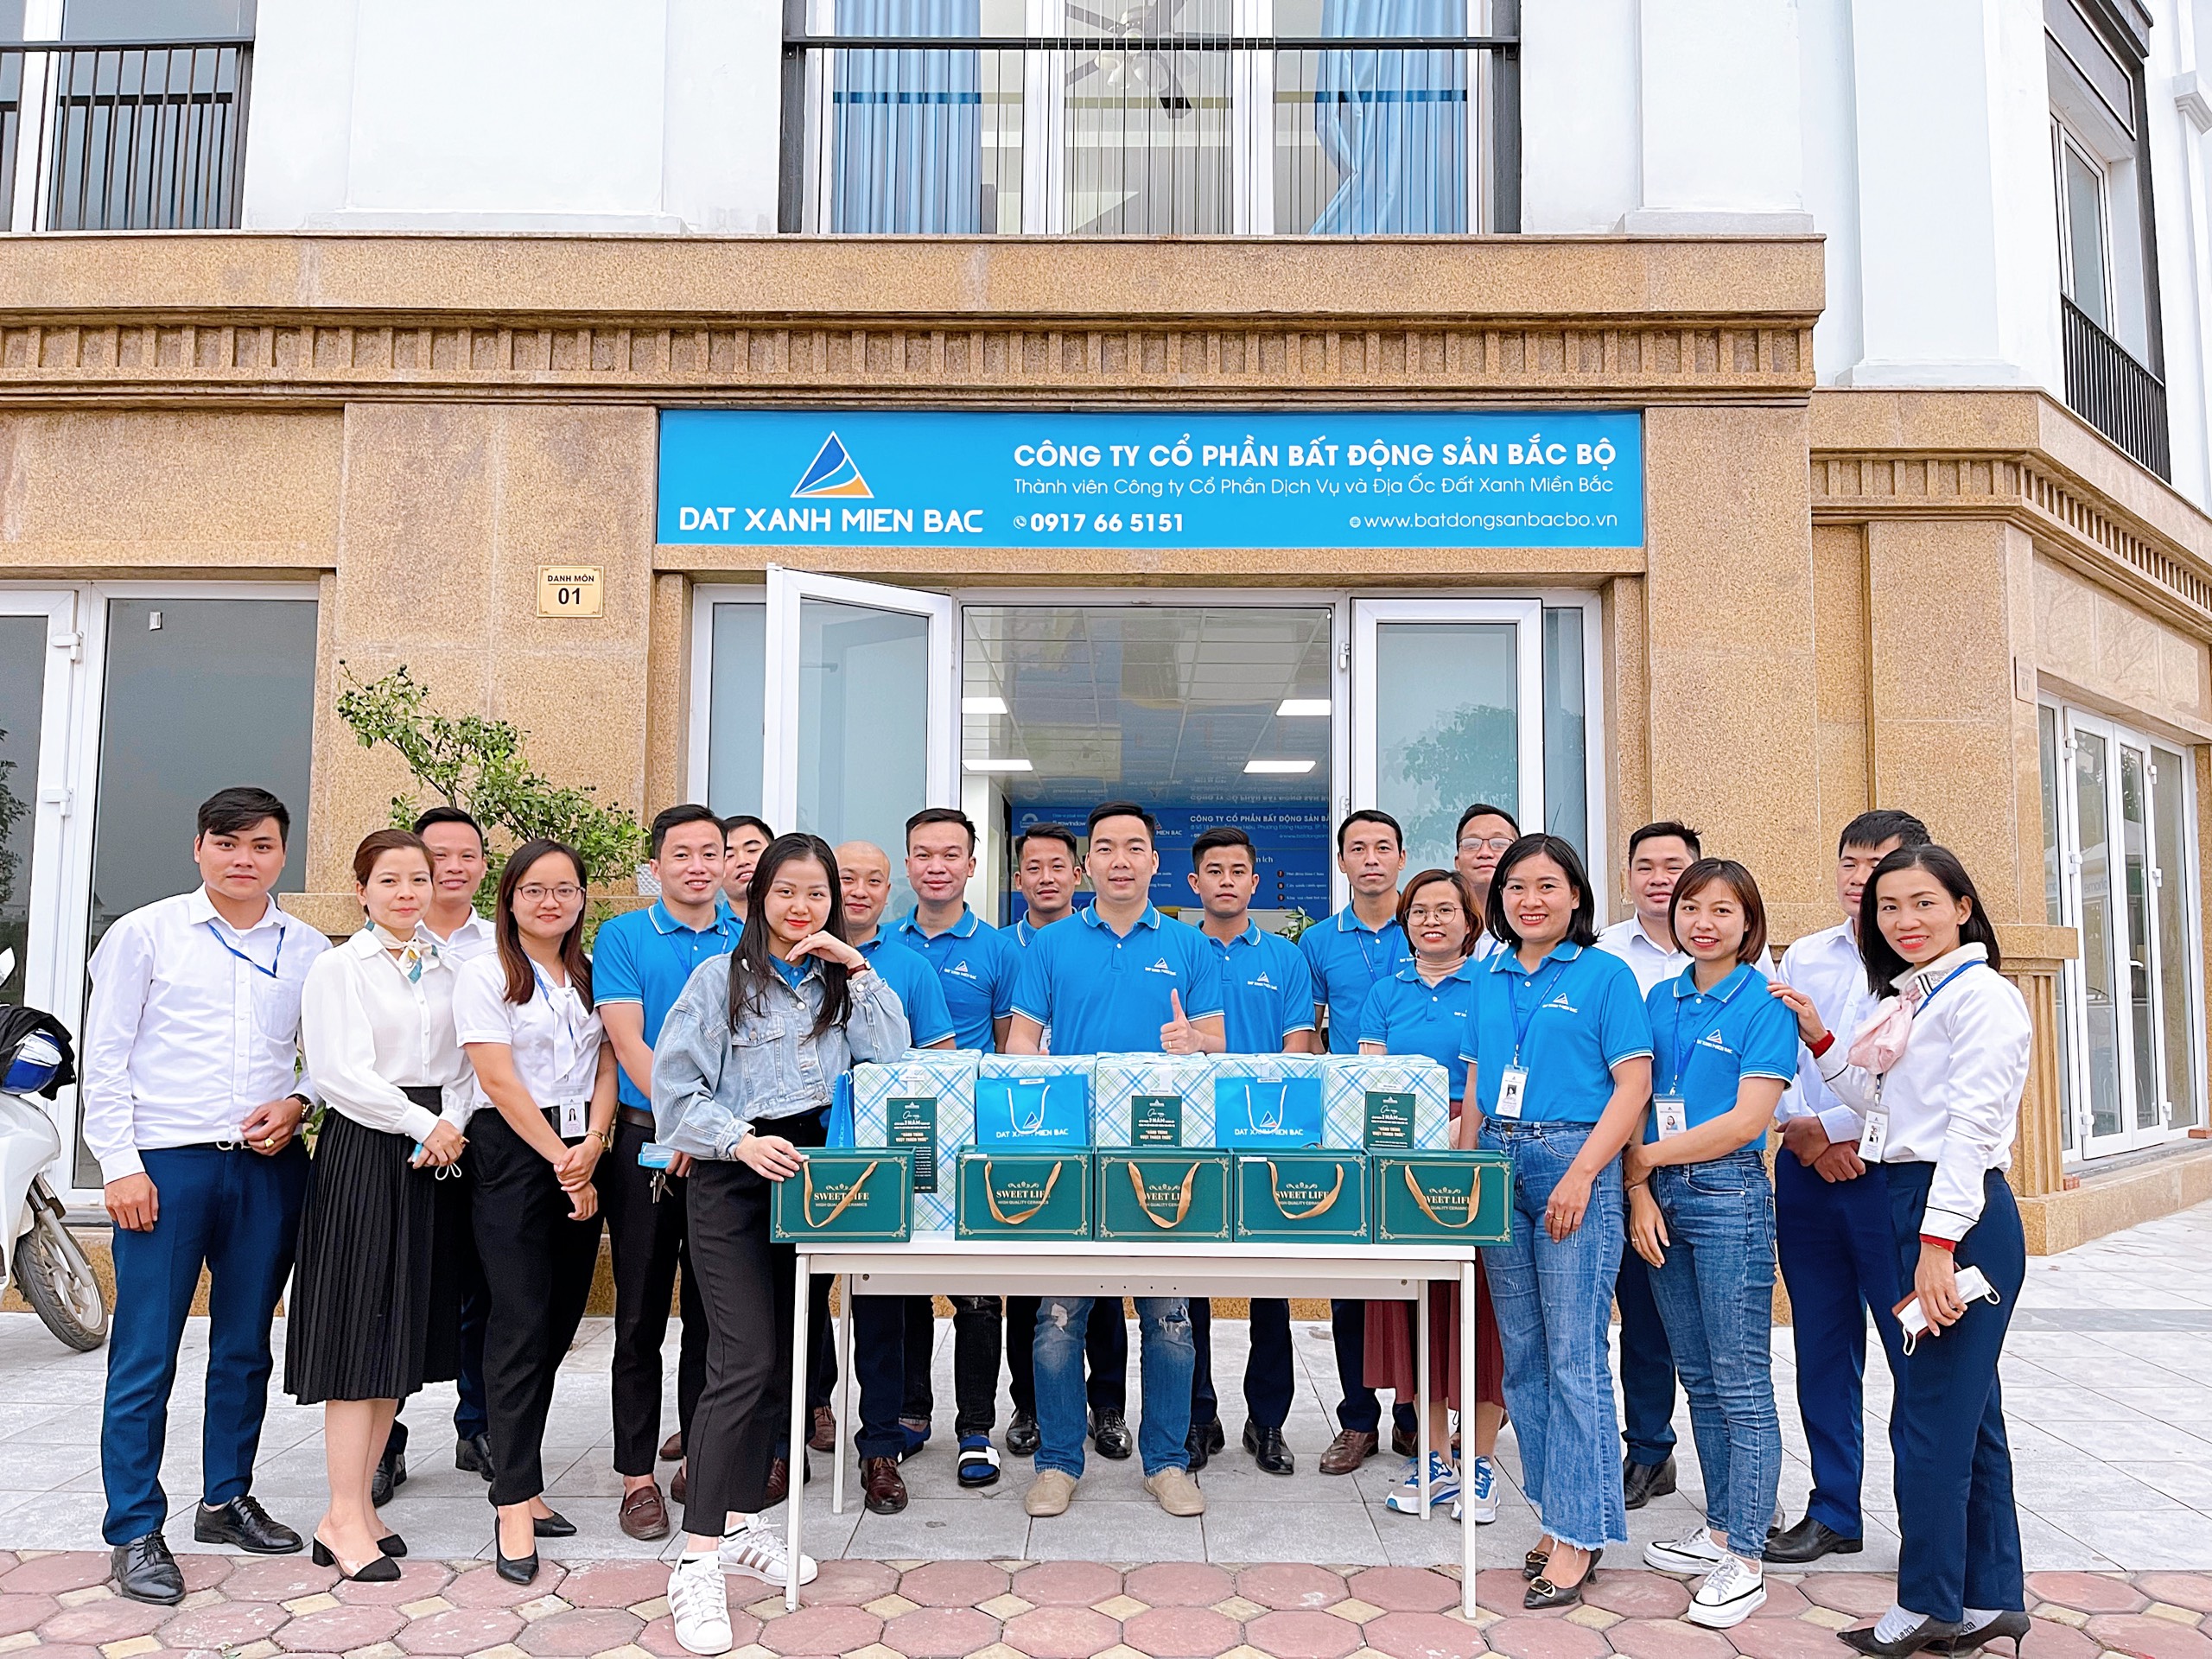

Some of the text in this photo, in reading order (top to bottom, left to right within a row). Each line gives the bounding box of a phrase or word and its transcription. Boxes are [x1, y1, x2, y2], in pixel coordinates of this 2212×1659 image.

[1014, 433, 1616, 473] CÔNG TY CỔ PHẦN BẤT ĐỘNG SẢN BẮC BỘ
[1014, 473, 1613, 498] Thành viên Công ty Cổ Phần Dịch Vụ và Địa Ốc Đất Xanh Miền Bắc
[679, 506, 983, 533] DAT XANH MIEN BAC
[1030, 512, 1183, 532] 0917 66 5151
[1364, 512, 1618, 531] www.batdongsanbacbo.vn
[574, 574, 594, 582] MÔN
[558, 588, 580, 605] 01
[1190, 814, 1214, 823] CÔNG
[814, 1192, 869, 1201] SWEET IFE
[996, 1190, 1050, 1198] SWEET LIF
